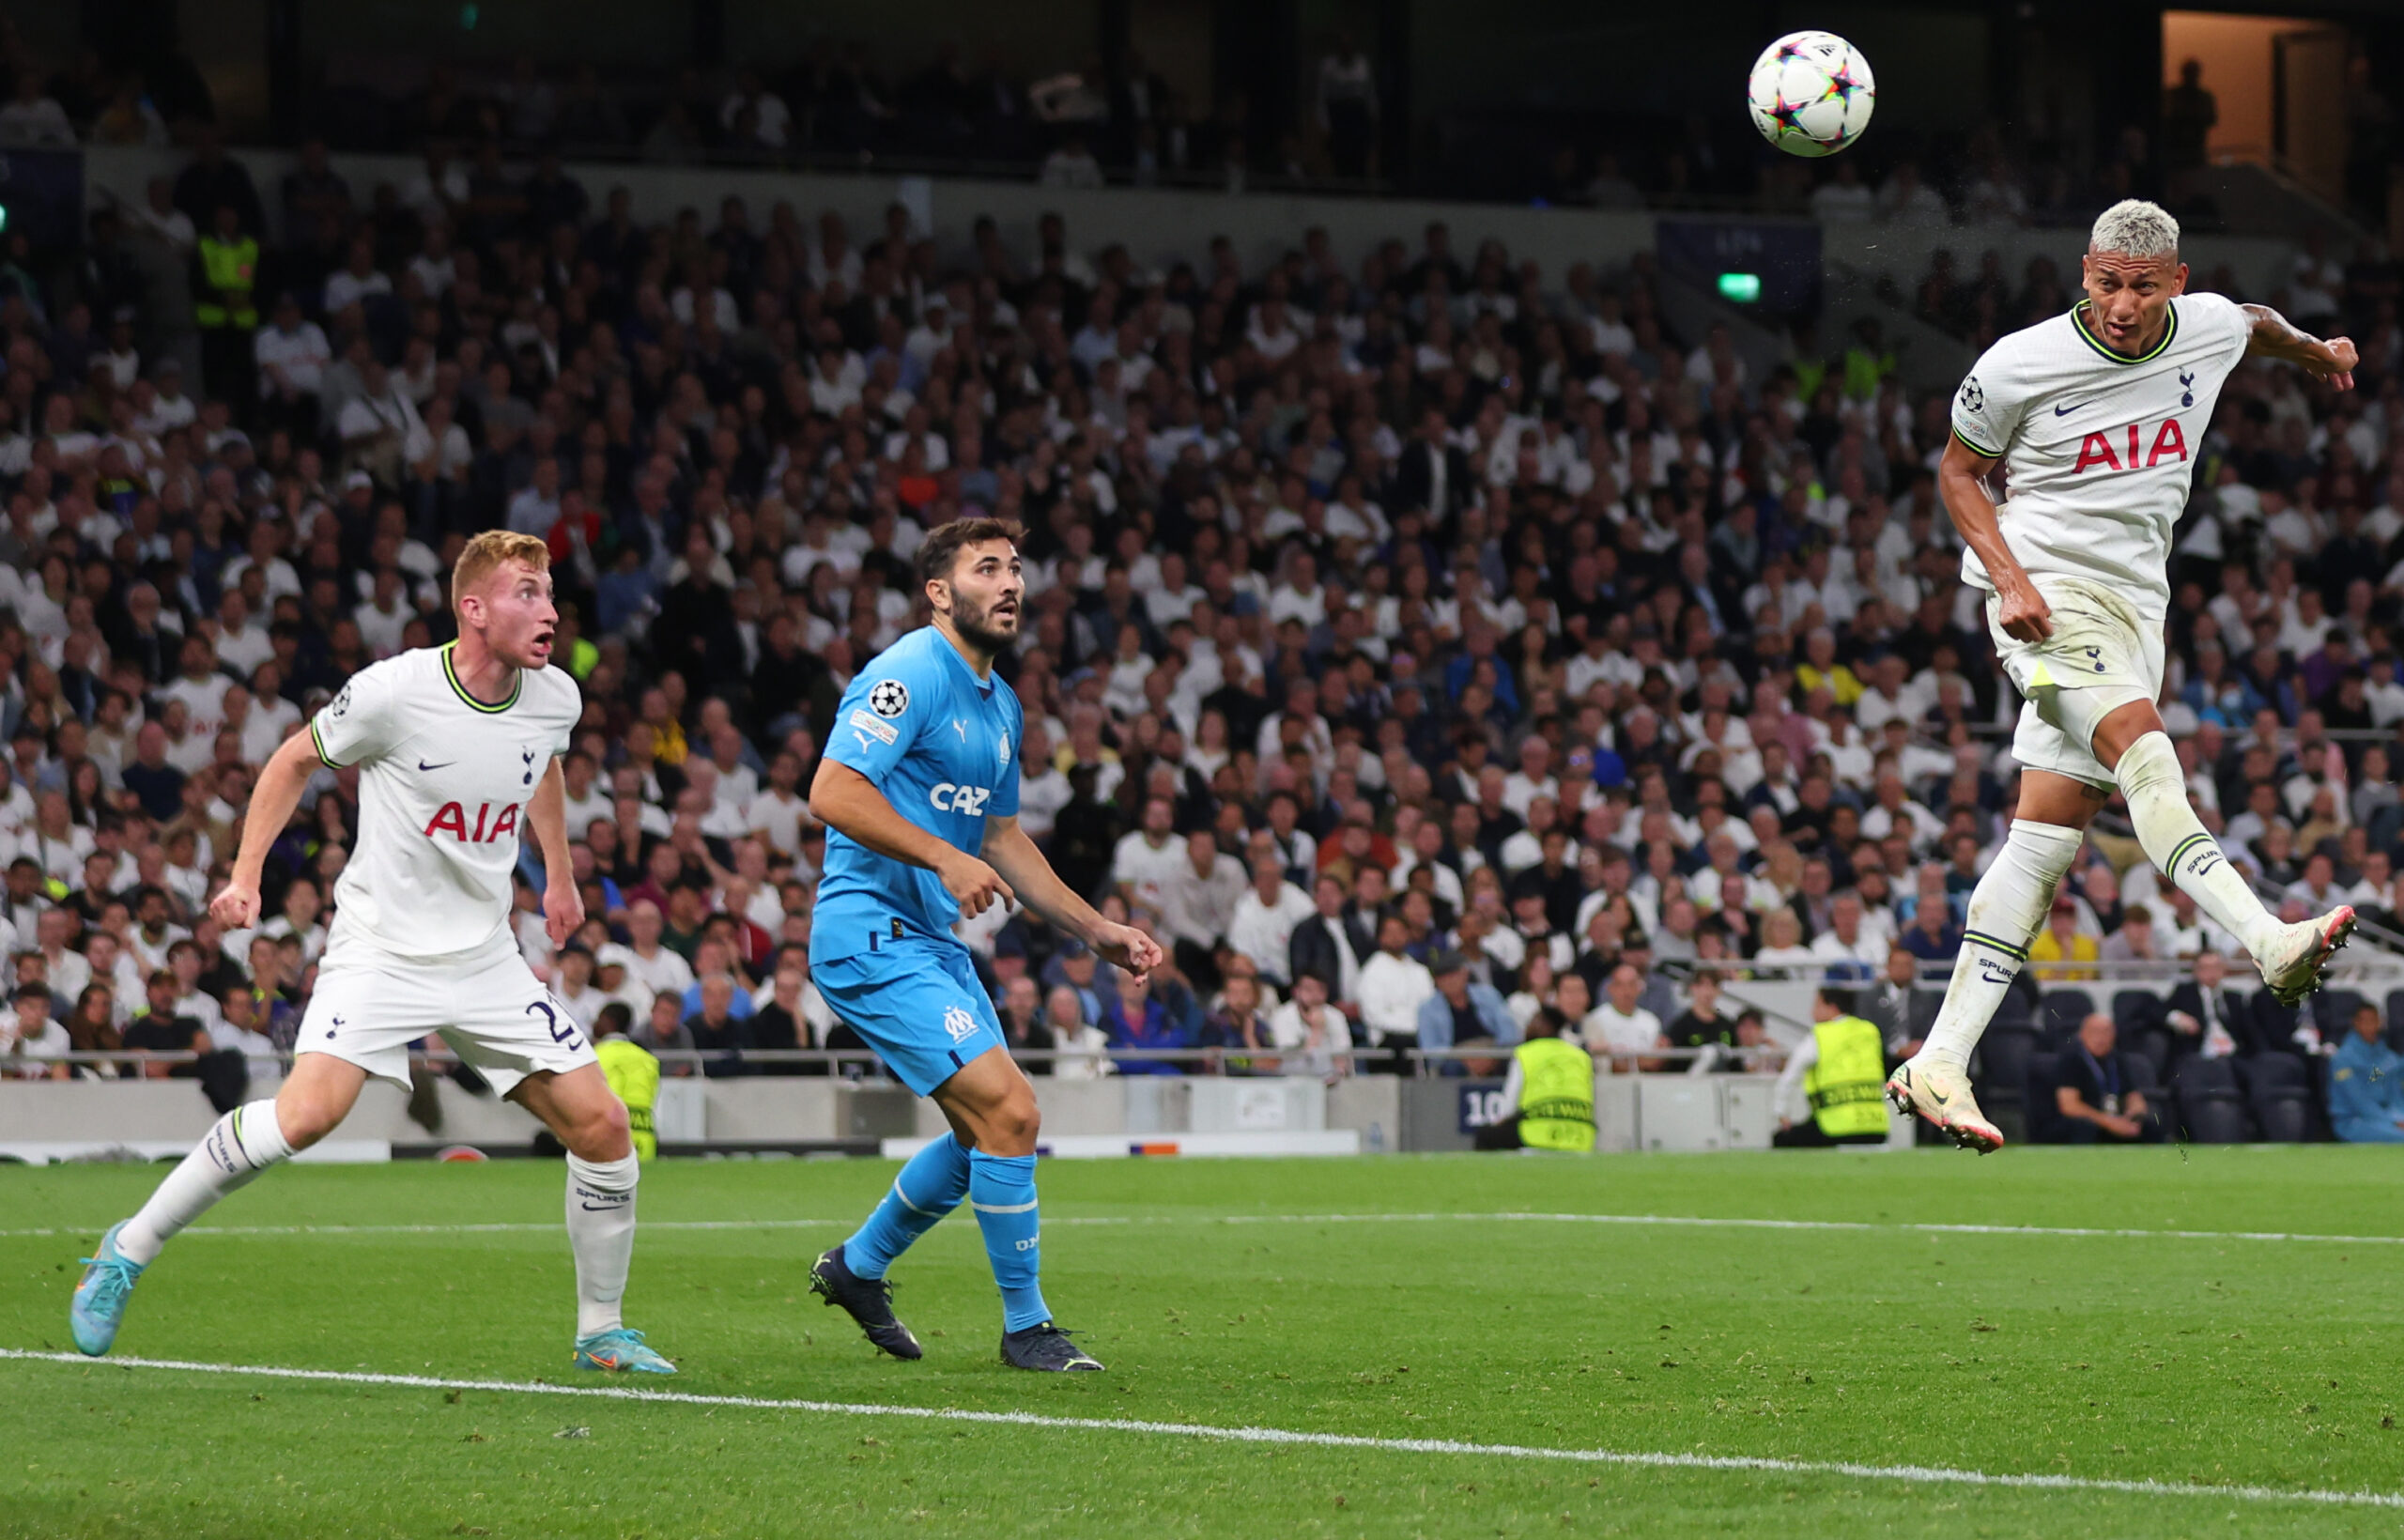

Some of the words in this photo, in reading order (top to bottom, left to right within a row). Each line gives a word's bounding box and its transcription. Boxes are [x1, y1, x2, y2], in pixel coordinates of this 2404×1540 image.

[2071, 418, 2188, 474] AIA
[424, 801, 519, 843] AIA
[1467, 1090, 1503, 1126] 10
[577, 1187, 630, 1202] SPURS
